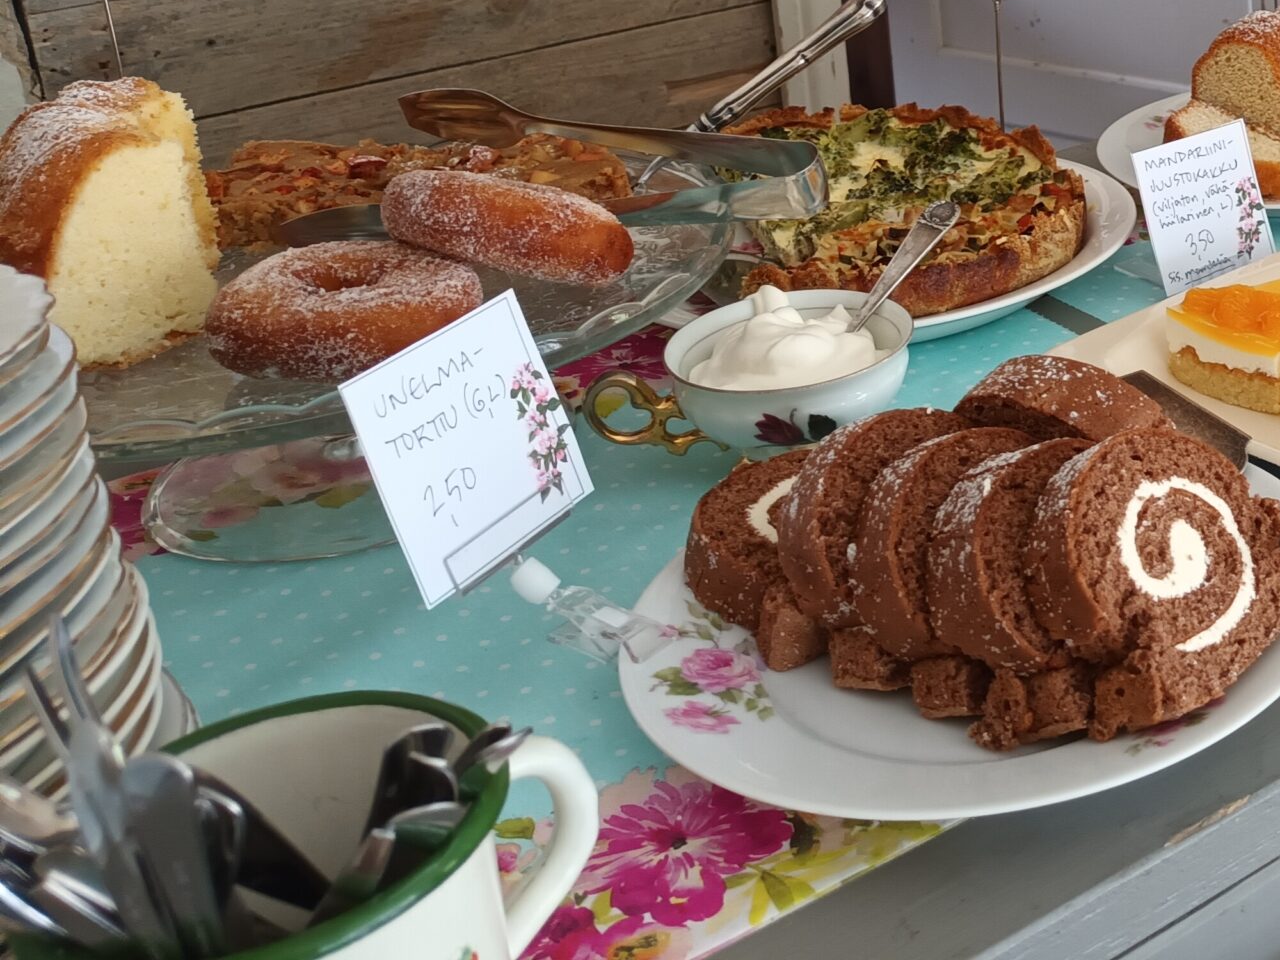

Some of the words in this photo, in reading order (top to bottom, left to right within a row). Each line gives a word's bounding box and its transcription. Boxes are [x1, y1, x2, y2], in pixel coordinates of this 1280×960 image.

[1145, 139, 1233, 172] MANDARIINI-
[1150, 159, 1238, 193] JUUSTOKAKKU
[1185, 229, 1215, 261] 3,50
[374, 347, 484, 419] UNELMA-
[385, 406, 458, 459] TORTTU
[424, 467, 477, 528] 2,50
